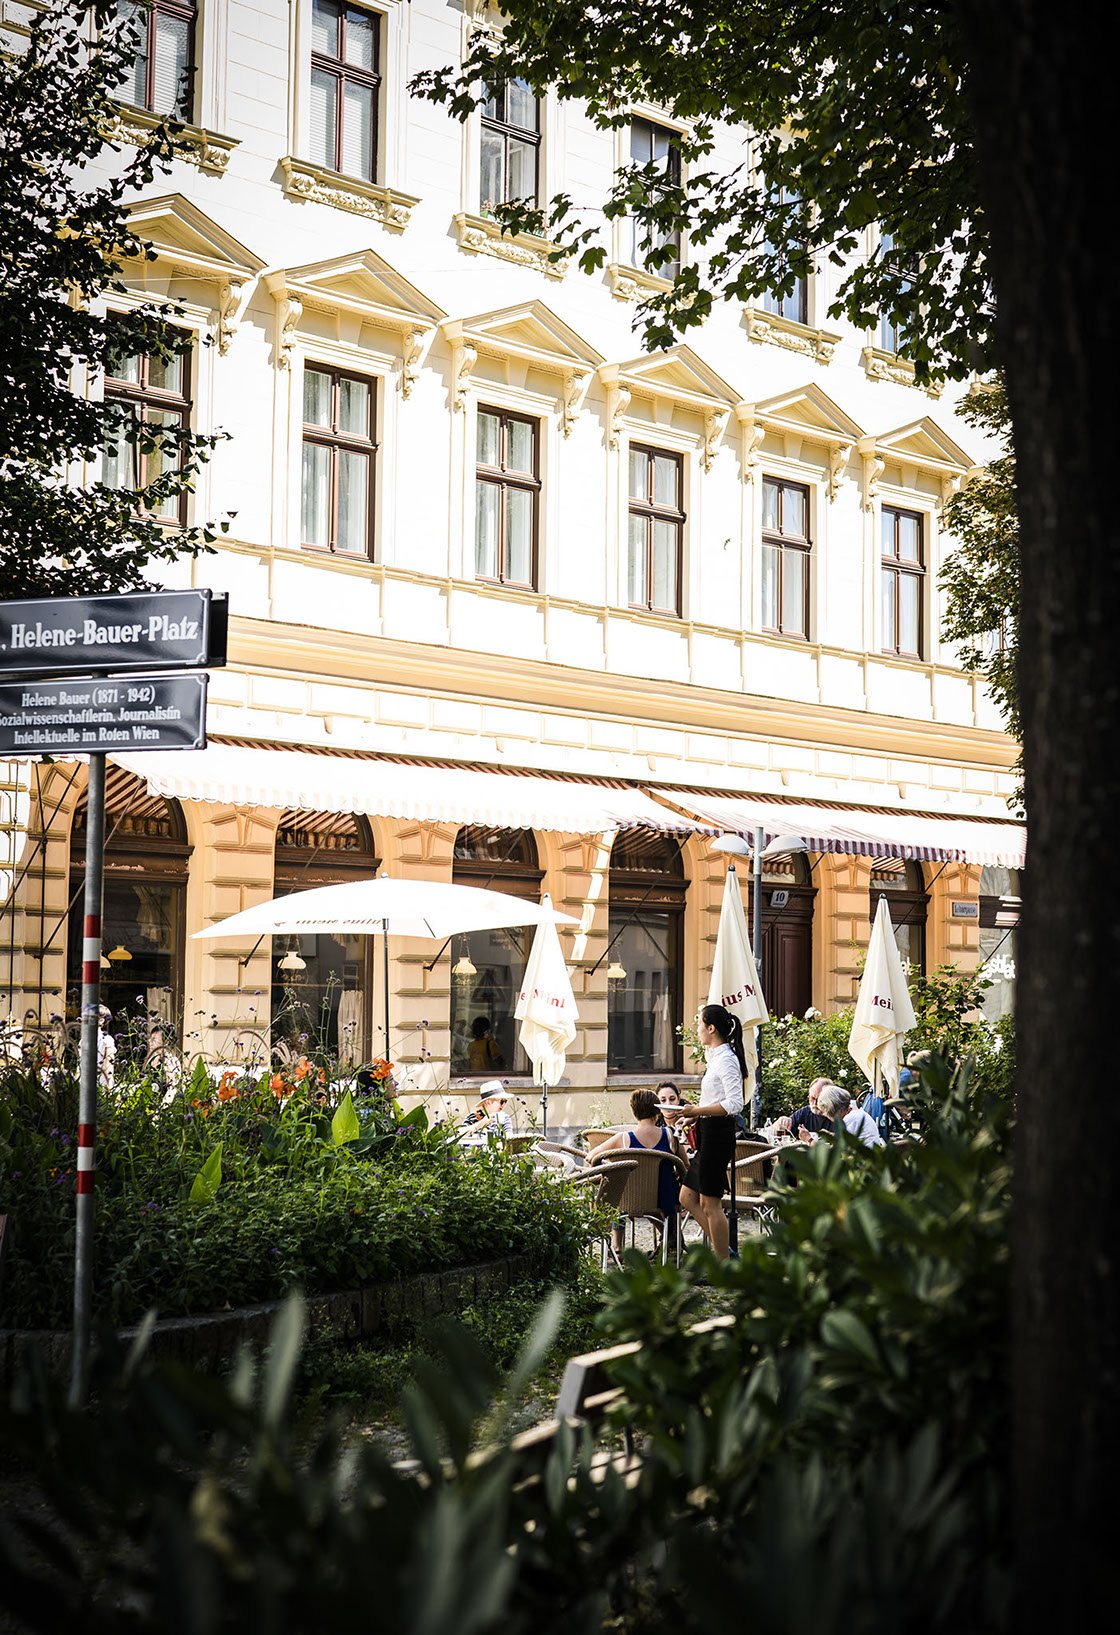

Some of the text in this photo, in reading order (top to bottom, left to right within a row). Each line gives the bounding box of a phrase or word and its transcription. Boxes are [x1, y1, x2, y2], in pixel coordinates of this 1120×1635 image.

[11, 615, 198, 649] Helene-Bauer-Platz
[22, 692, 57, 707] Helene
[58, 691, 90, 705] Bauer
[92, 687, 119, 706] (1871
[127, 685, 155, 705] 1942)
[0, 705, 181, 726] ozialwissenschaftlerin, Journalistin
[14, 725, 159, 744] Intellektuelle im Roten Wien
[775, 892, 785, 902] 10
[721, 991, 743, 1007] ius
